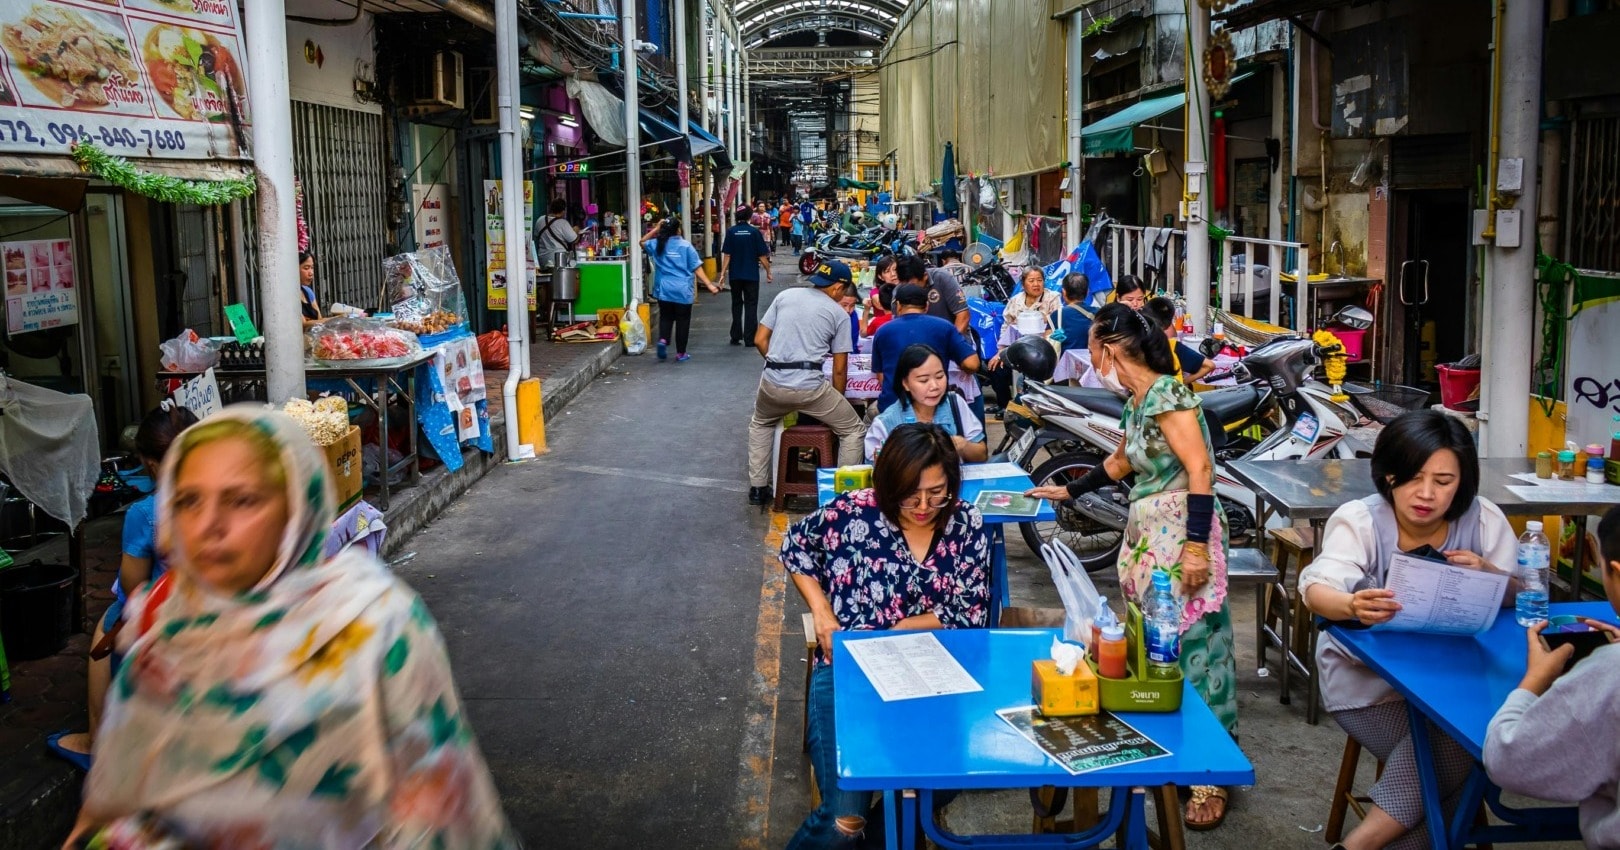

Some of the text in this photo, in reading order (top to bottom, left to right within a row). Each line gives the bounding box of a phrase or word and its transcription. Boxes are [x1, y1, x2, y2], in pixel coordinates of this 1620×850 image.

[192, 0, 229, 16] ราดหนา
[103, 74, 143, 108] สุกี้แห้ง
[0, 120, 186, 151] 72, 096-840-7680
[559, 162, 588, 172] OPEN
